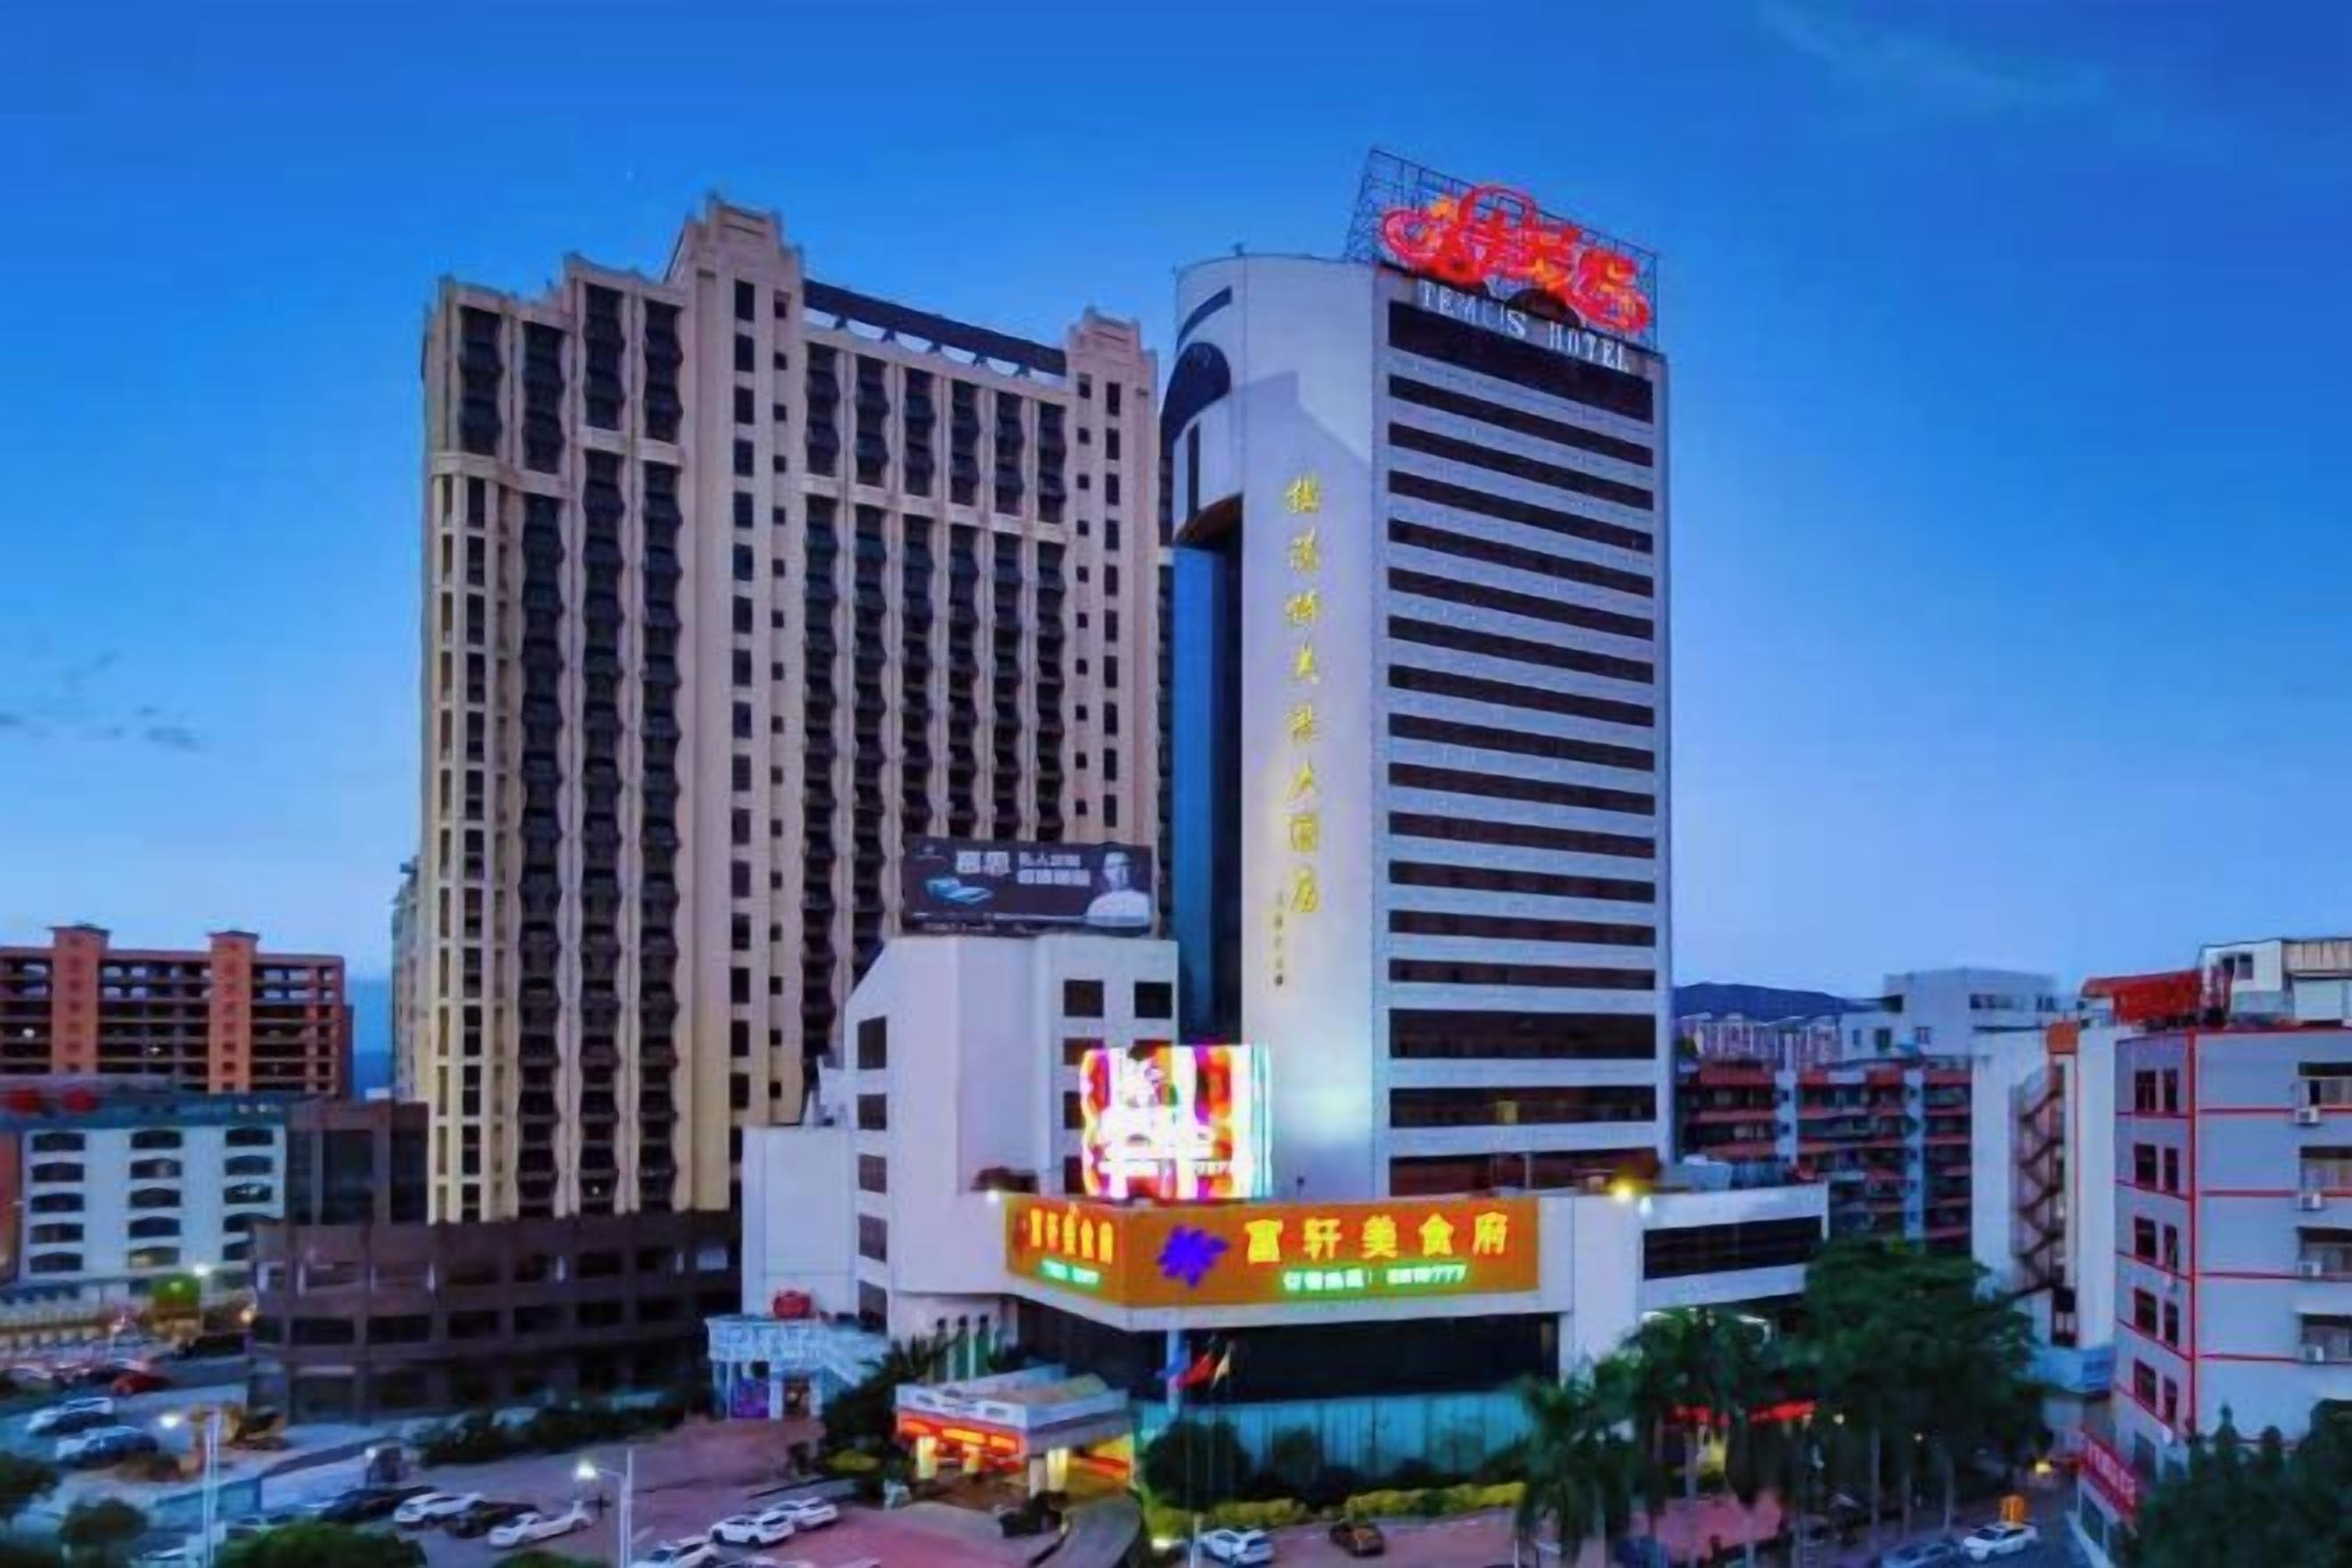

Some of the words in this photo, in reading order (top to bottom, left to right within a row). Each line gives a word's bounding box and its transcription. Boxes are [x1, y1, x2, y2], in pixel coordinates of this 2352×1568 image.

[1547, 319, 1629, 373] HOTEL
[1245, 1212, 1508, 1264] 富轩美食府
